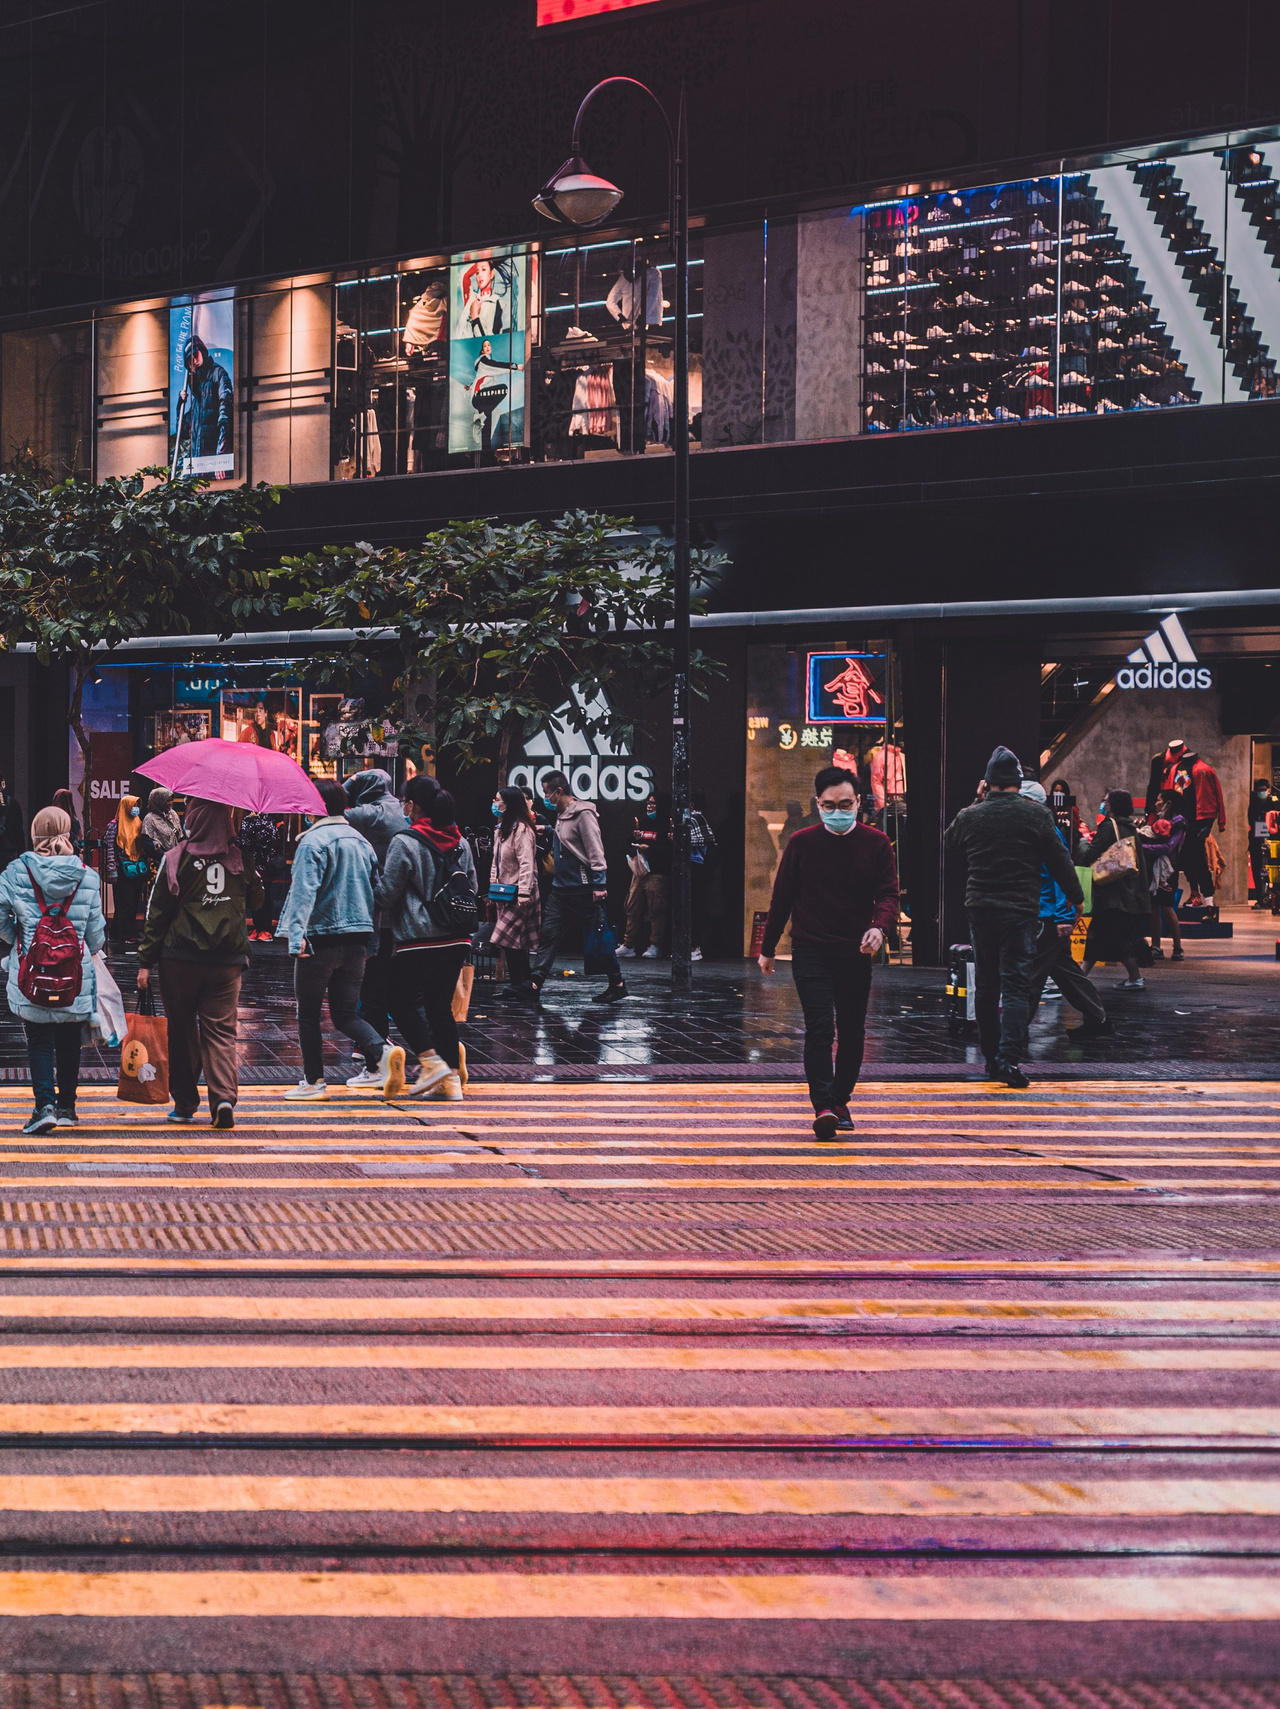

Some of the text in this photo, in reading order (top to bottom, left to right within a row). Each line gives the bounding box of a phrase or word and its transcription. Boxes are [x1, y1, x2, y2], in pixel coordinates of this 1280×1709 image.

[1116, 662, 1212, 689] adidas
[90, 780, 130, 799] SALE
[206, 863, 225, 894] 9
